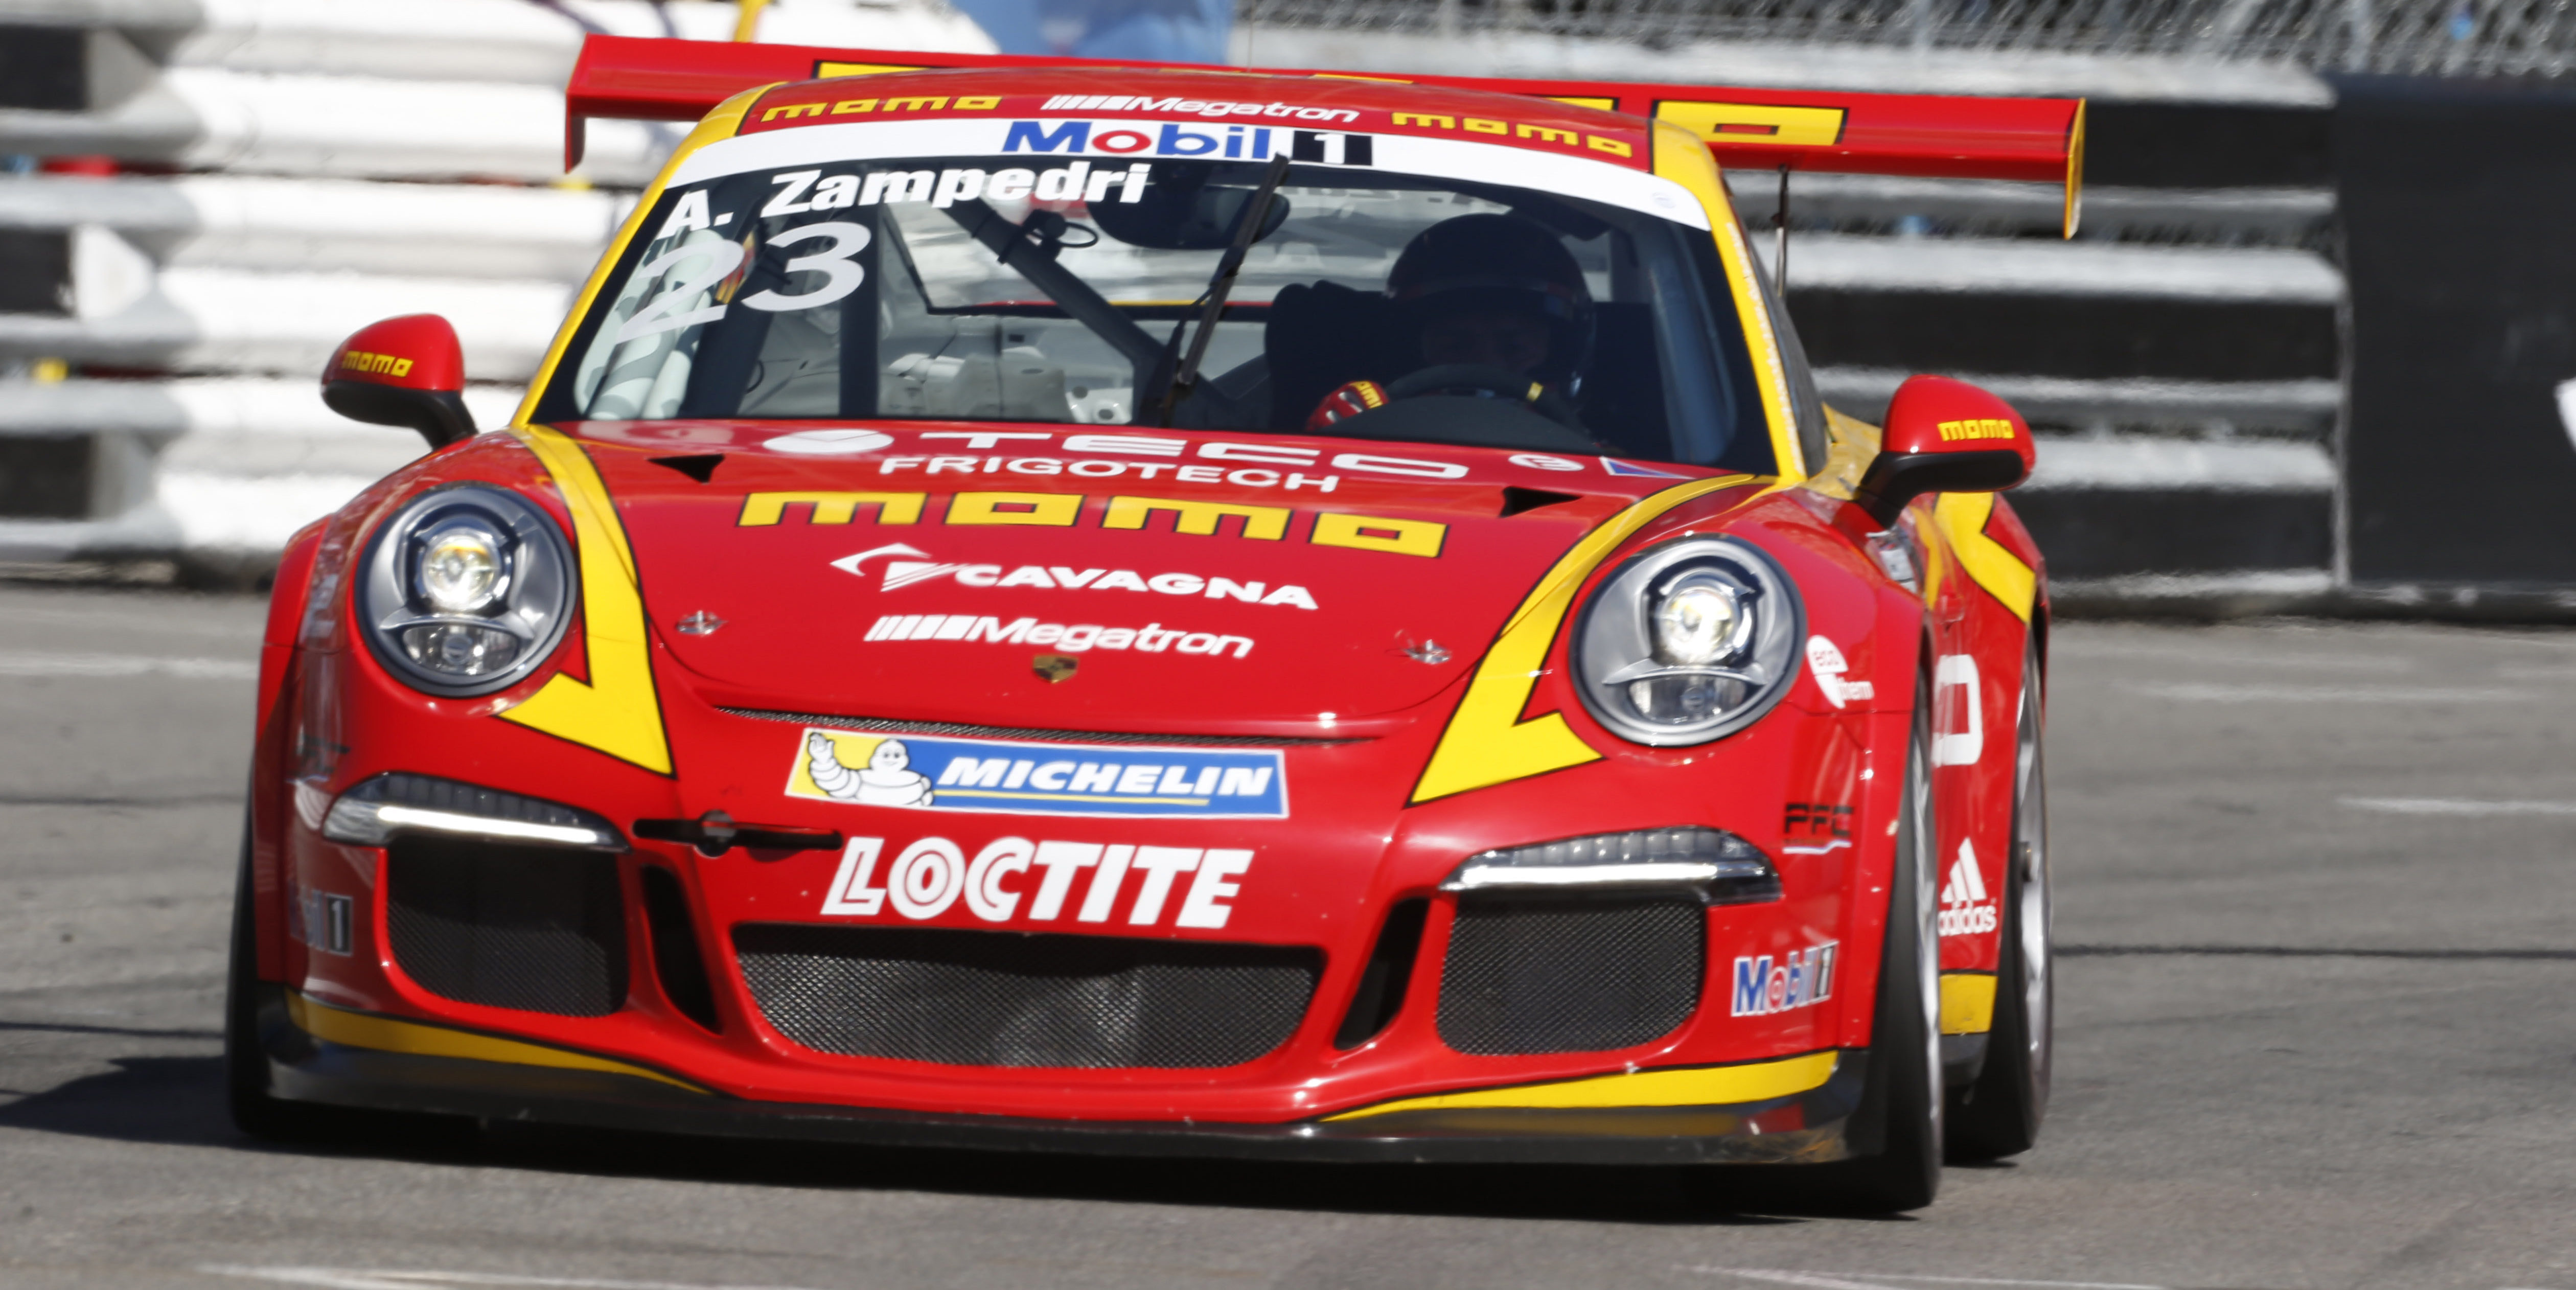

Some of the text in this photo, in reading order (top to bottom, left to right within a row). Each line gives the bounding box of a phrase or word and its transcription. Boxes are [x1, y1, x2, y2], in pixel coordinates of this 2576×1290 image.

[760, 96, 1004, 123] momo
[1126, 96, 1360, 123] Megatron
[1002, 121, 1271, 159] Mobil
[1391, 111, 1633, 158] momo
[656, 161, 1151, 240] A. Zampedri
[616, 221, 871, 344] 23
[341, 350, 414, 378] momo
[1937, 420, 2015, 442] momo
[880, 456, 1339, 492] FRIGOTECH
[920, 432, 1470, 478] TECO
[736, 491, 1451, 558] momo
[955, 564, 1319, 610] CAVAGNA
[965, 616, 1254, 659] Megatron
[936, 756, 1274, 797] MICHELIN
[1784, 803, 1853, 837] PFC
[819, 836, 1255, 929] LOCTITE
[1937, 899, 1997, 937] adidas
[1731, 947, 1819, 1017] Mobil
